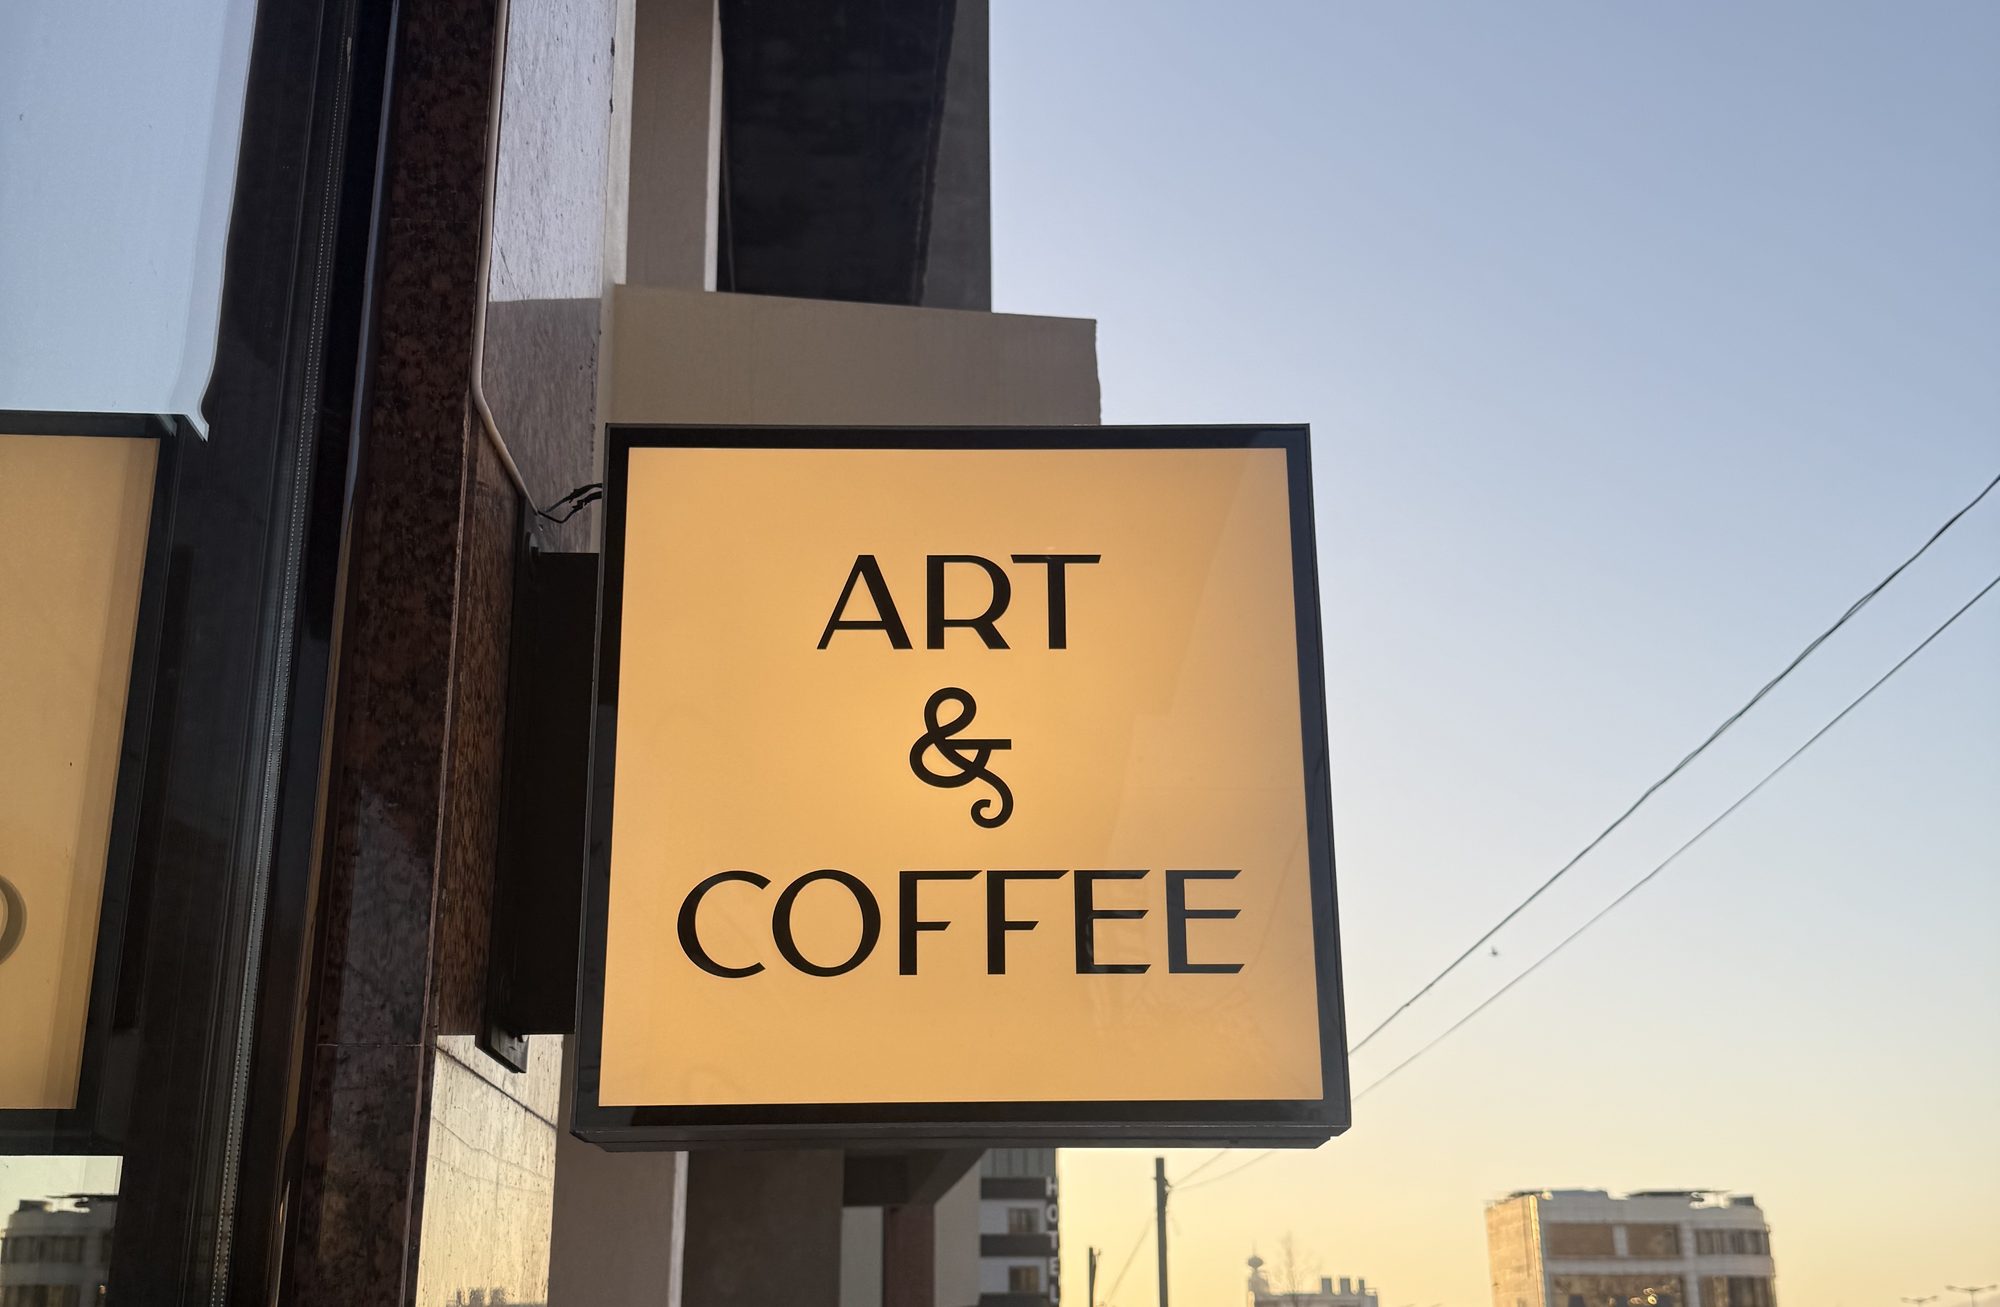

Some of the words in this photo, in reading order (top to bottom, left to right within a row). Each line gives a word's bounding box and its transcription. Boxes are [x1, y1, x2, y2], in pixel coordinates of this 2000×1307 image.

[817, 554, 1101, 650] ART
[910, 687, 1013, 828] &
[677, 869, 1244, 979] COFFEE
[1045, 1177, 1059, 1304] HOTEL
